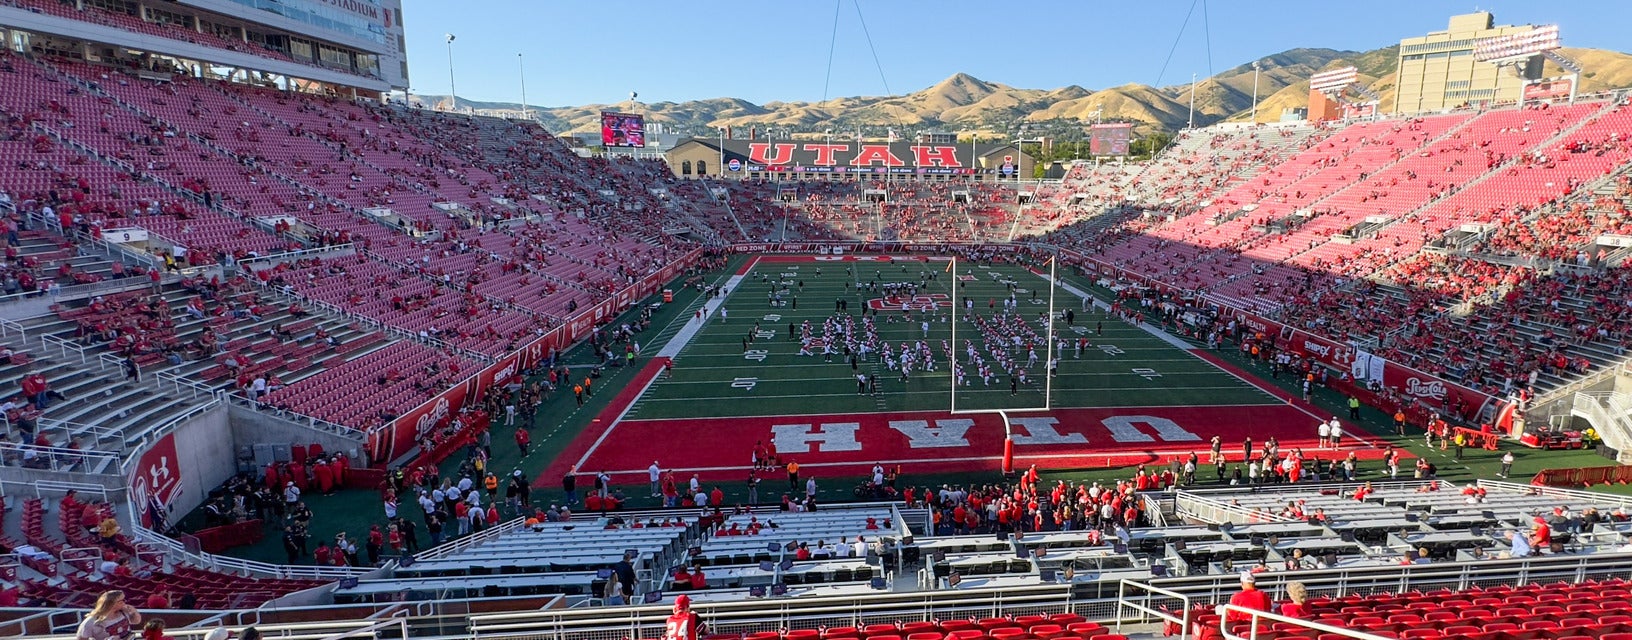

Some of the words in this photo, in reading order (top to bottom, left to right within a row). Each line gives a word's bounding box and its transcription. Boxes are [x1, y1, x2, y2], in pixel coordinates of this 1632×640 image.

[331, 0, 378, 19] STADIUM
[749, 143, 962, 166] UTAH
[123, 233, 130, 241] 9
[1304, 340, 1331, 358] SHIPEX
[771, 415, 1203, 454] UTAH
[667, 620, 689, 640] 24
